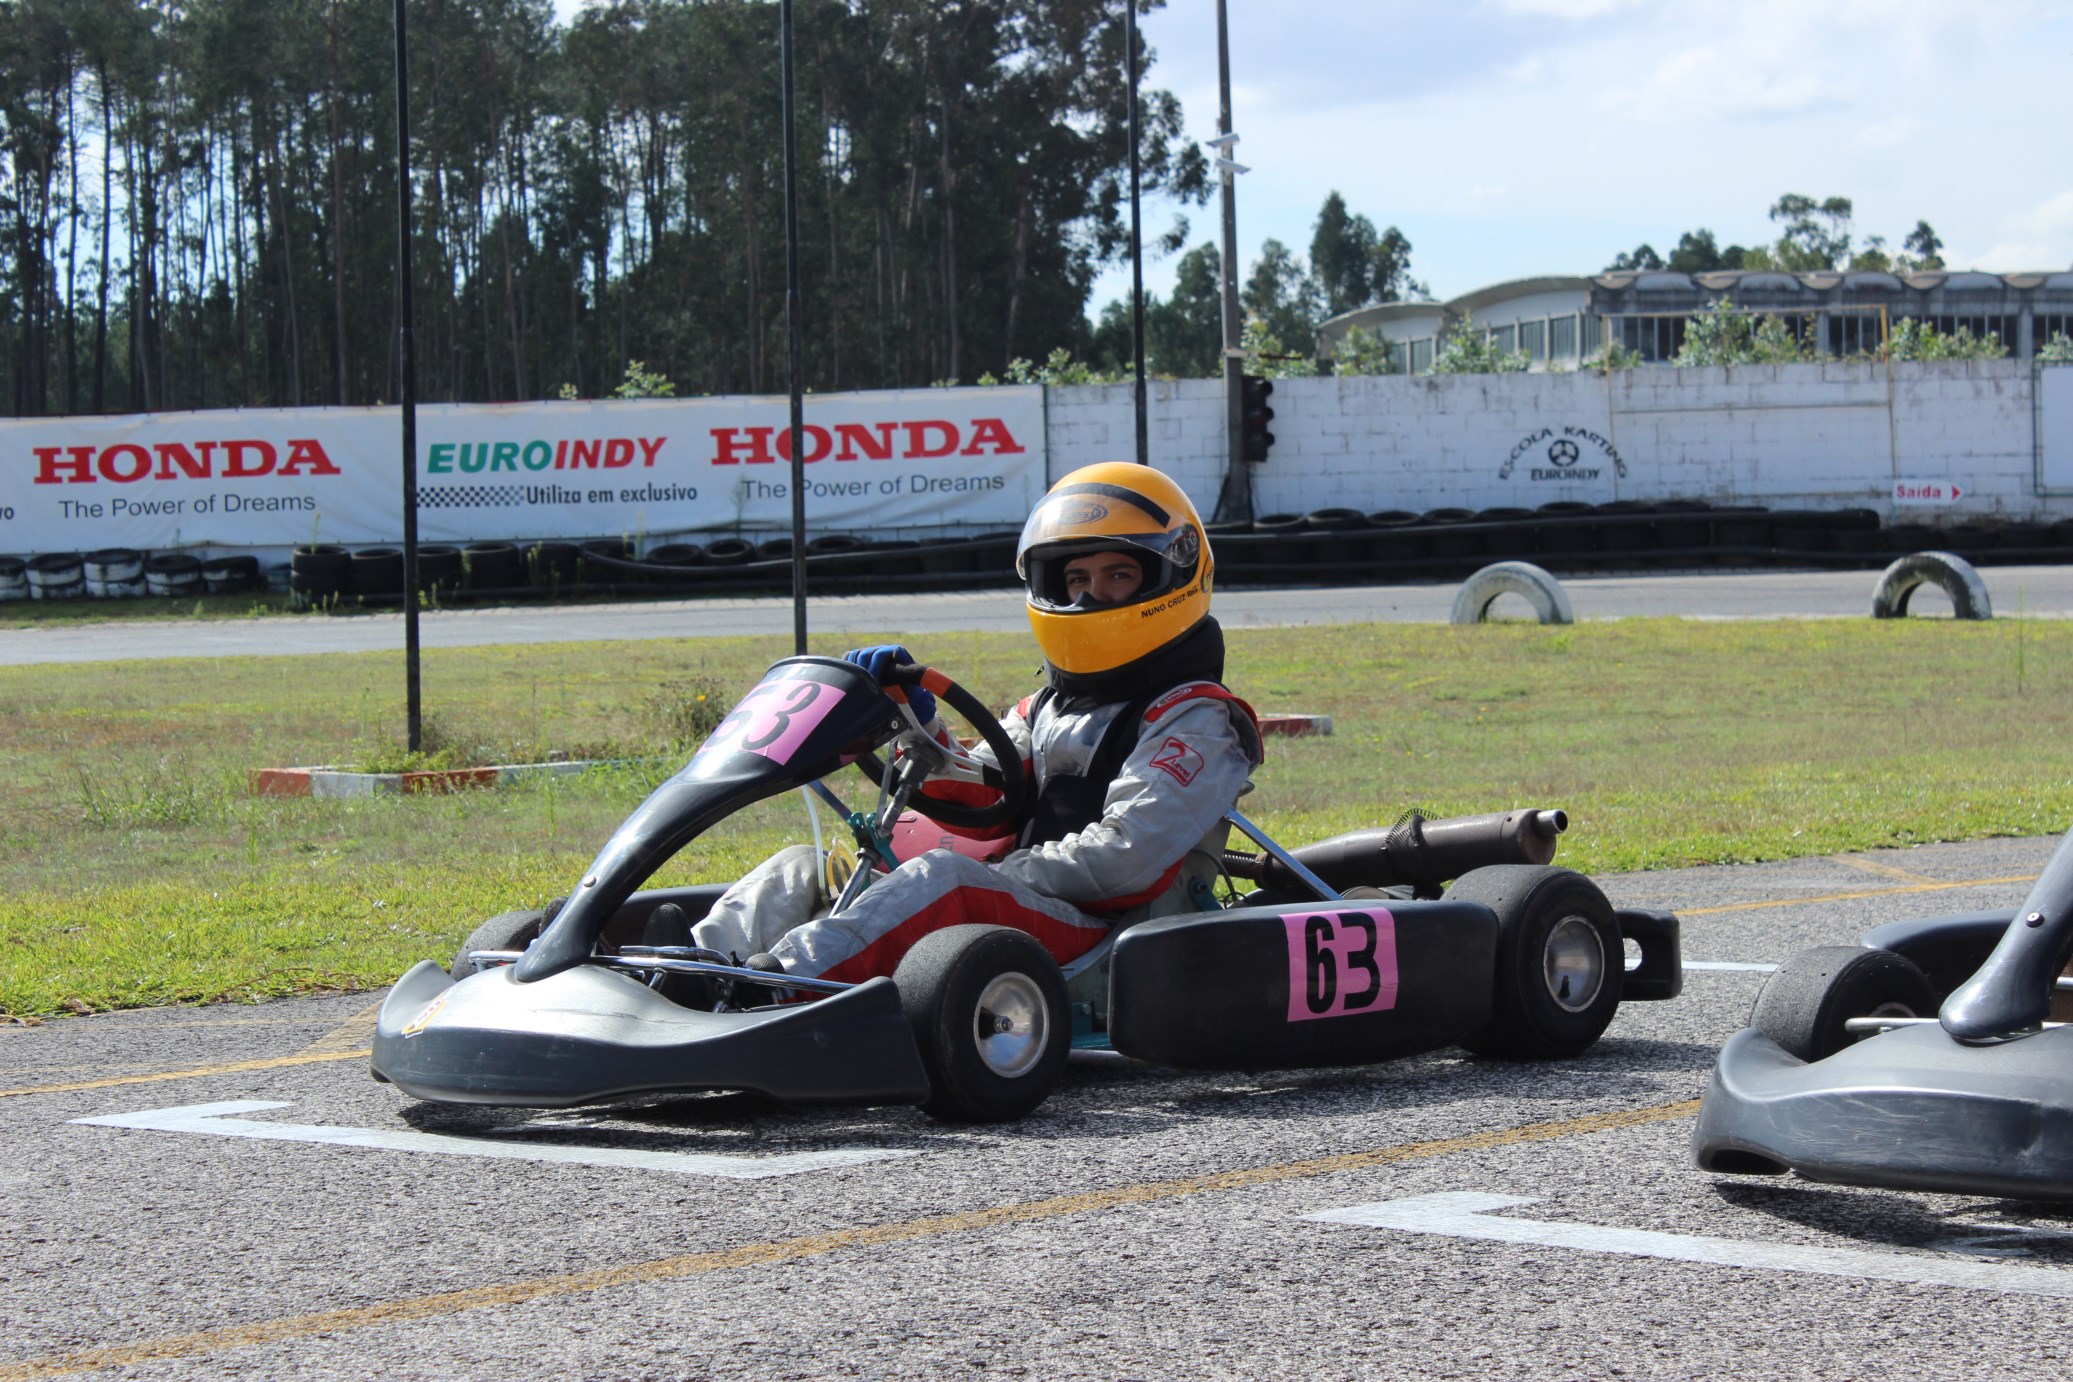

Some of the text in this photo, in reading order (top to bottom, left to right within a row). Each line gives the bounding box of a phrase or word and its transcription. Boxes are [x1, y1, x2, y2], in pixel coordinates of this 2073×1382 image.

[427, 437, 667, 474] EUROINDY
[711, 418, 1025, 465] HONDA
[1499, 426, 1628, 480] ESCOLA KARTING
[33, 439, 341, 485] HONDA
[1531, 468, 1600, 481] EUROINDY
[526, 482, 698, 504] Utiliza em exclusivo
[742, 479, 787, 498] The
[879, 476, 903, 495] of
[911, 475, 1005, 493] Dreams
[58, 493, 316, 519] The Power of Dreams
[1141, 604, 1166, 618] NUNO
[1168, 593, 1187, 608] CRUZ
[1305, 912, 1381, 1014] 63
